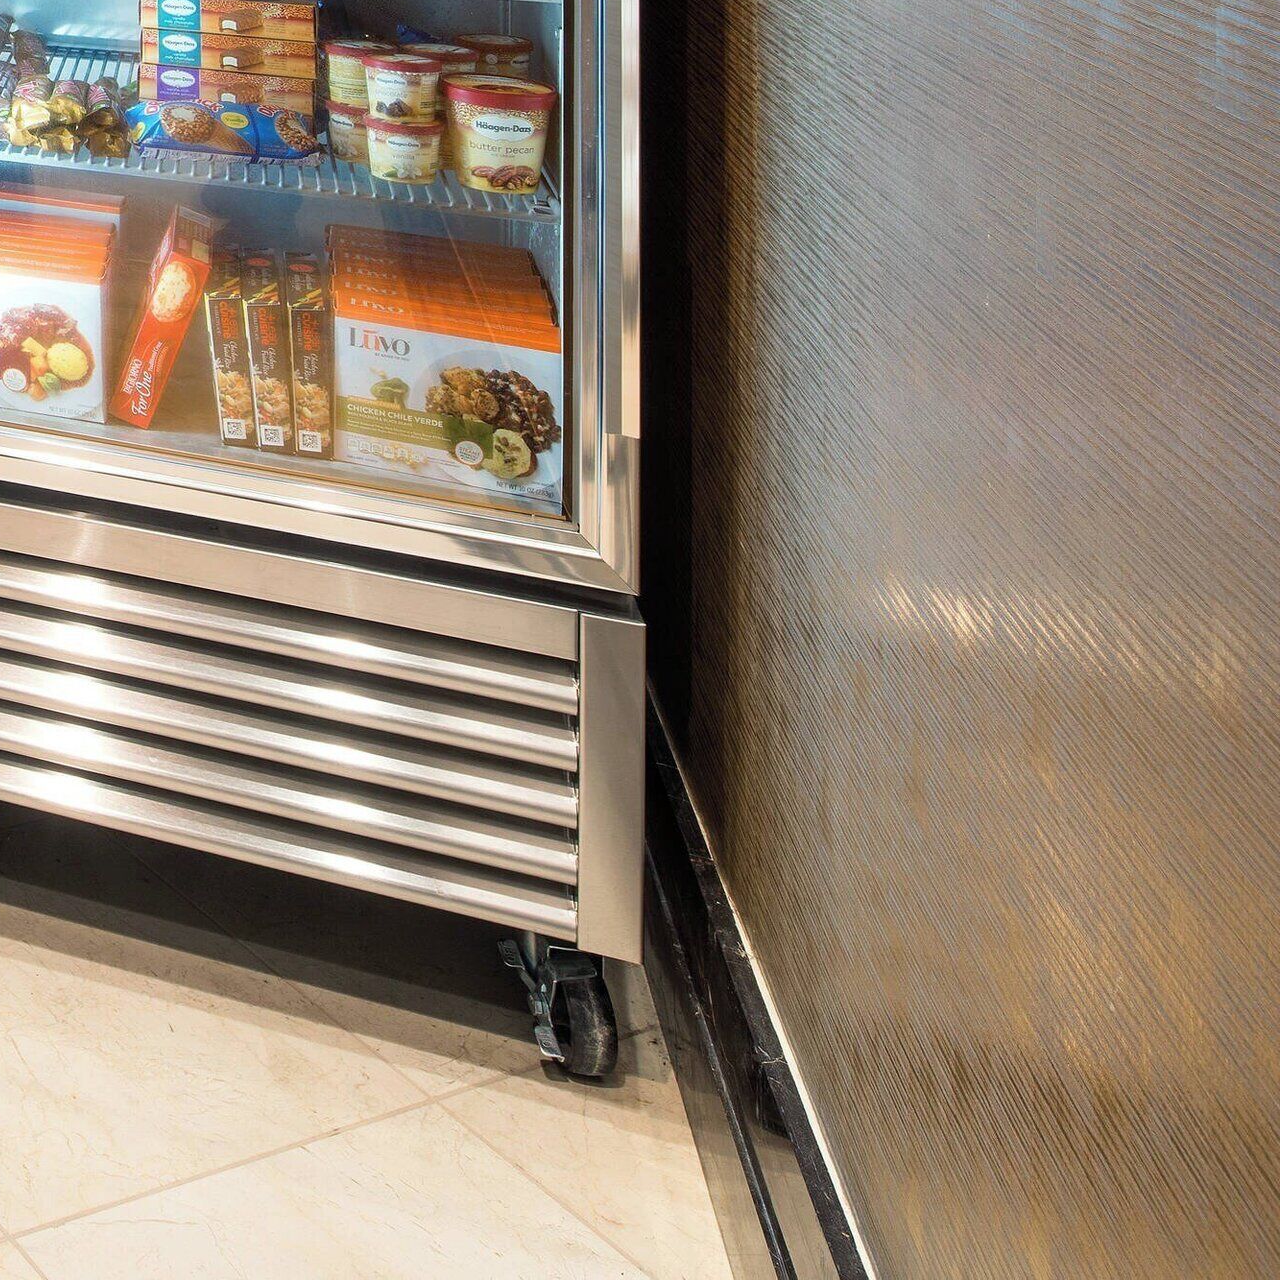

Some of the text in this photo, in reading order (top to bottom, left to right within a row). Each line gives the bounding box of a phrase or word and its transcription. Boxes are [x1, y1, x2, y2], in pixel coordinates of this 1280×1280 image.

[469, 140, 536, 156] butter pecan
[346, 403, 386, 418] CHICKEN
[387, 410, 414, 422] CHILE
[413, 415, 444, 429] VERDE
